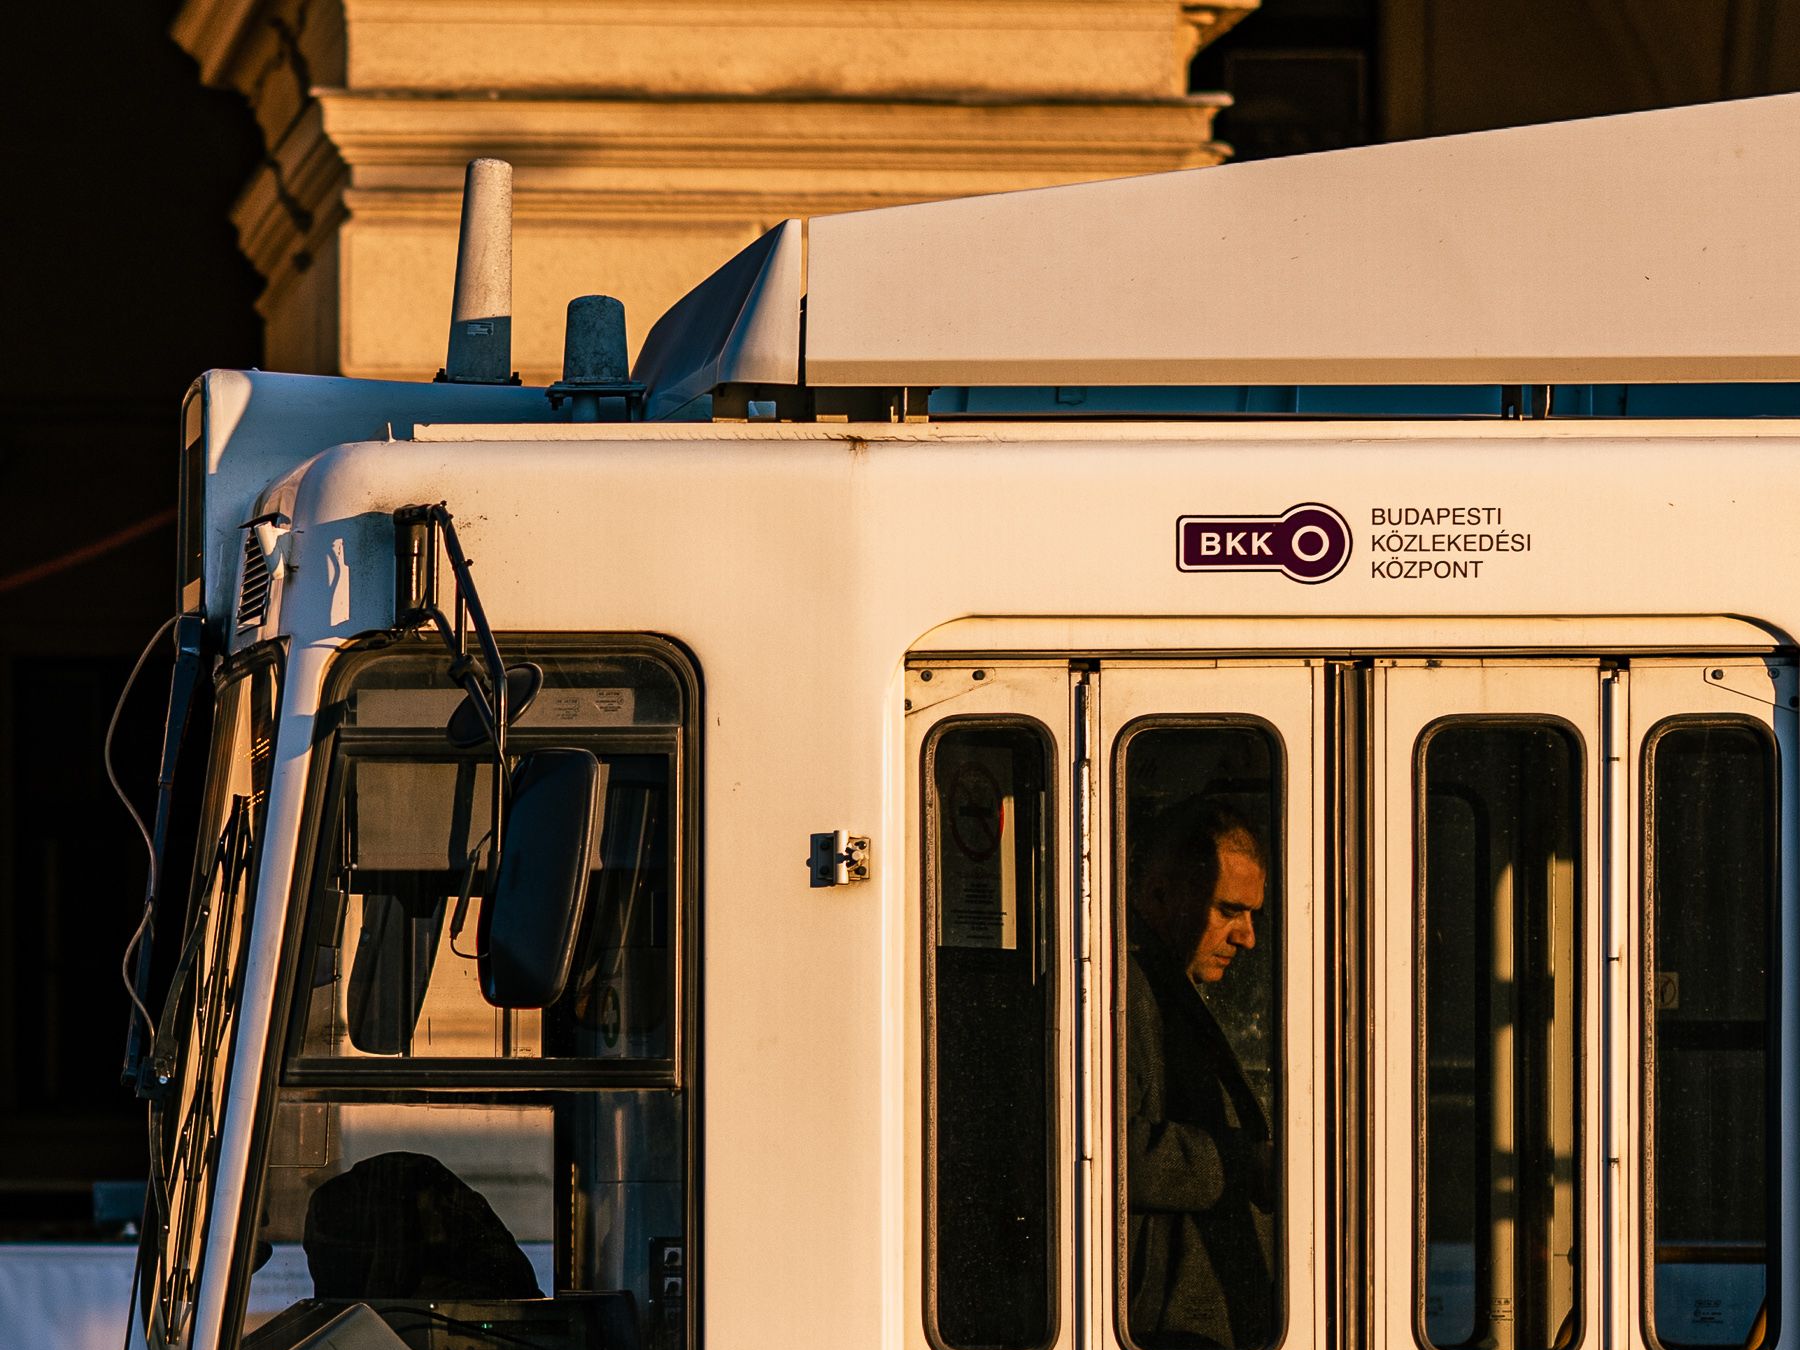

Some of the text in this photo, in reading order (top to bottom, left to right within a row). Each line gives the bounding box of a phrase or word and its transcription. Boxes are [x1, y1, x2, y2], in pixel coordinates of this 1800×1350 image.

[1372, 508, 1501, 526] BUDAPESTI
[1201, 532, 1272, 555] BKK
[1372, 530, 1530, 552] KÖZLEKEDÉSI
[1372, 557, 1483, 579] KÖZPONT
